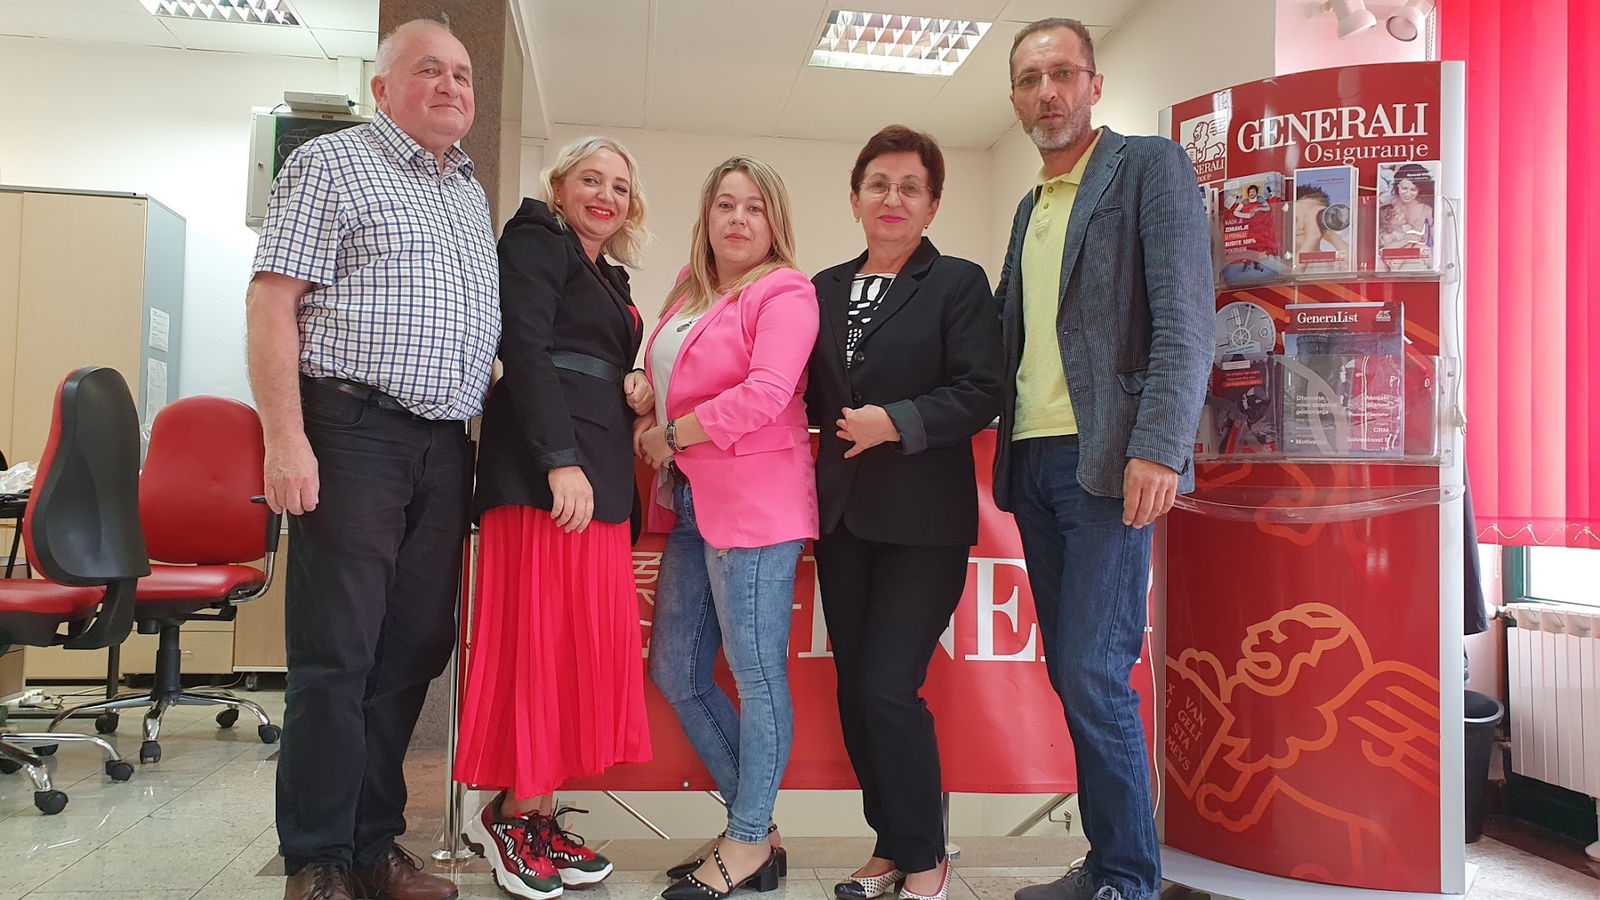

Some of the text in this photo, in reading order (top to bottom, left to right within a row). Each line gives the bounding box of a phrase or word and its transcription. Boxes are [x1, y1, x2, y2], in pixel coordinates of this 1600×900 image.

[1236, 103, 1429, 153] GENERALI
[1304, 138, 1429, 164] Osiguranje
[1297, 311, 1358, 324] GeneraList
